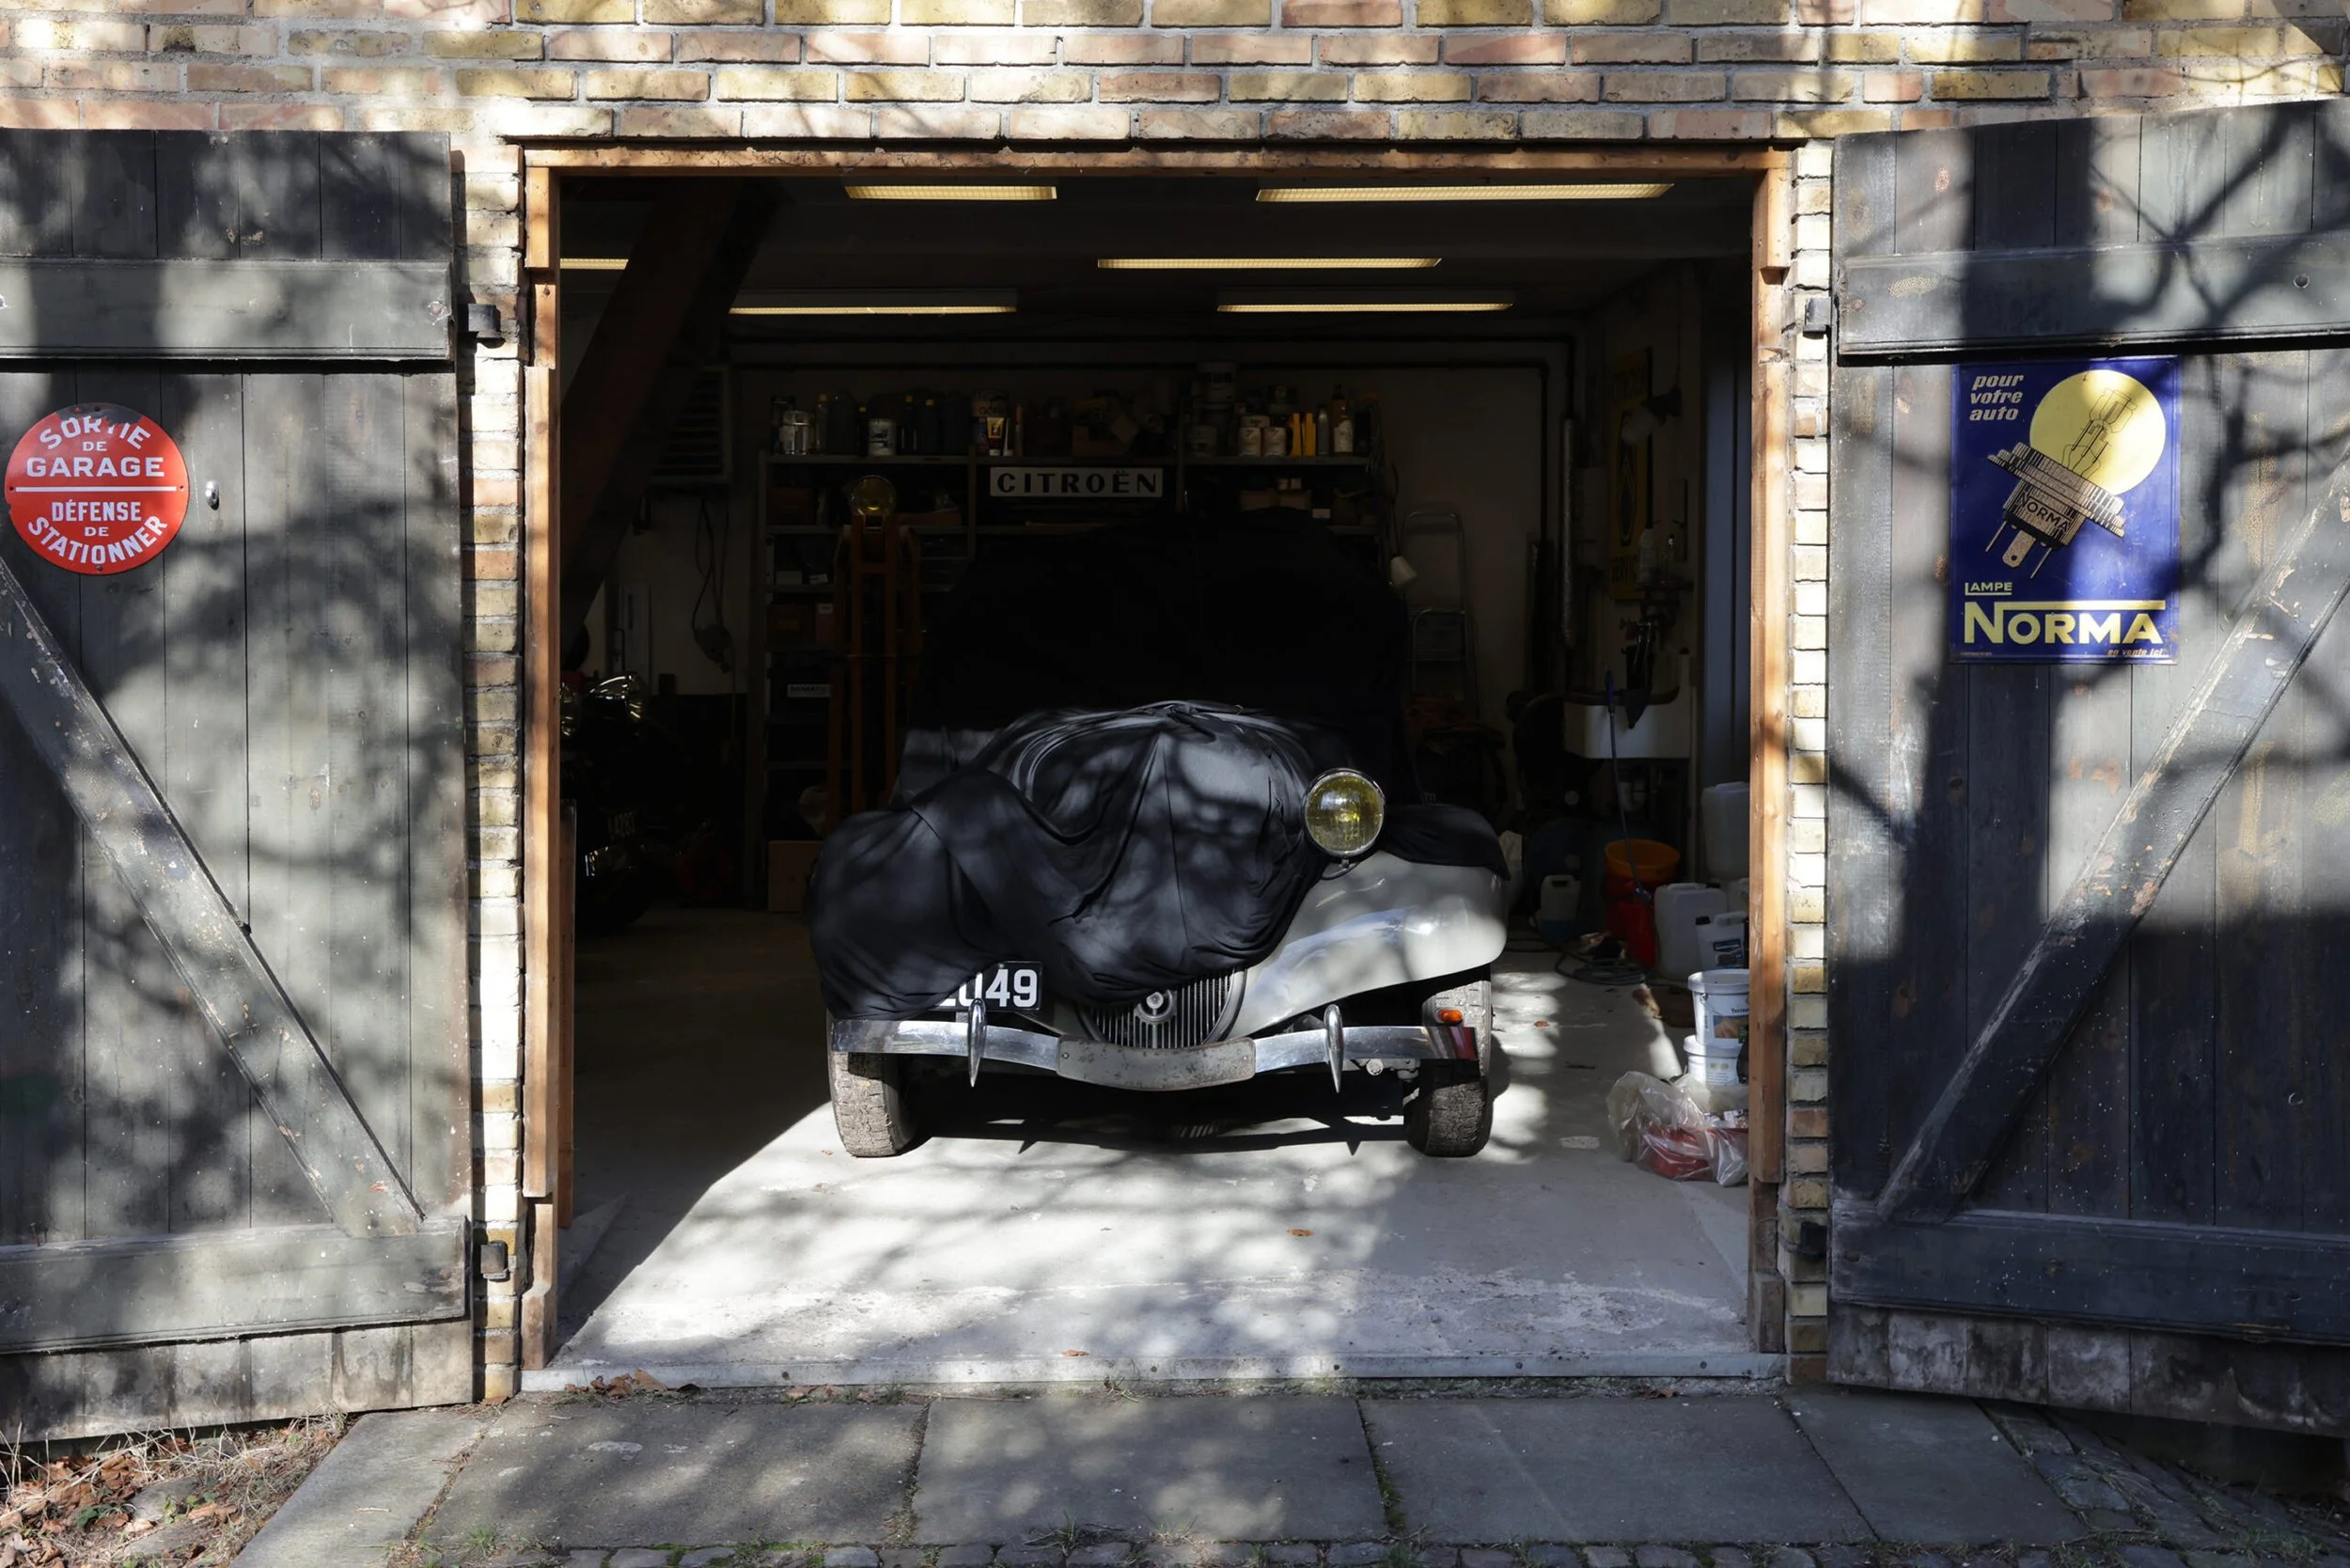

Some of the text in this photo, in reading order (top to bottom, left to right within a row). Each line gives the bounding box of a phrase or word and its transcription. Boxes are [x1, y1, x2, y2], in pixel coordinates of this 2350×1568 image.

[1971, 374, 2025, 391] pour
[1970, 389, 2023, 404] votre
[1969, 406, 2019, 421] auto
[83, 441, 107, 452] DE
[26, 457, 165, 478] GARAGE
[996, 470, 1159, 494] CITROËN
[51, 499, 142, 522] DÉFENSE
[2016, 492, 2073, 533] NORMA
[28, 515, 168, 564] STATIONNER
[85, 526, 109, 537] DE
[1965, 581, 2013, 596] LAMPE
[1964, 600, 2166, 645] NORMA
[939, 968, 1038, 1008] 049
